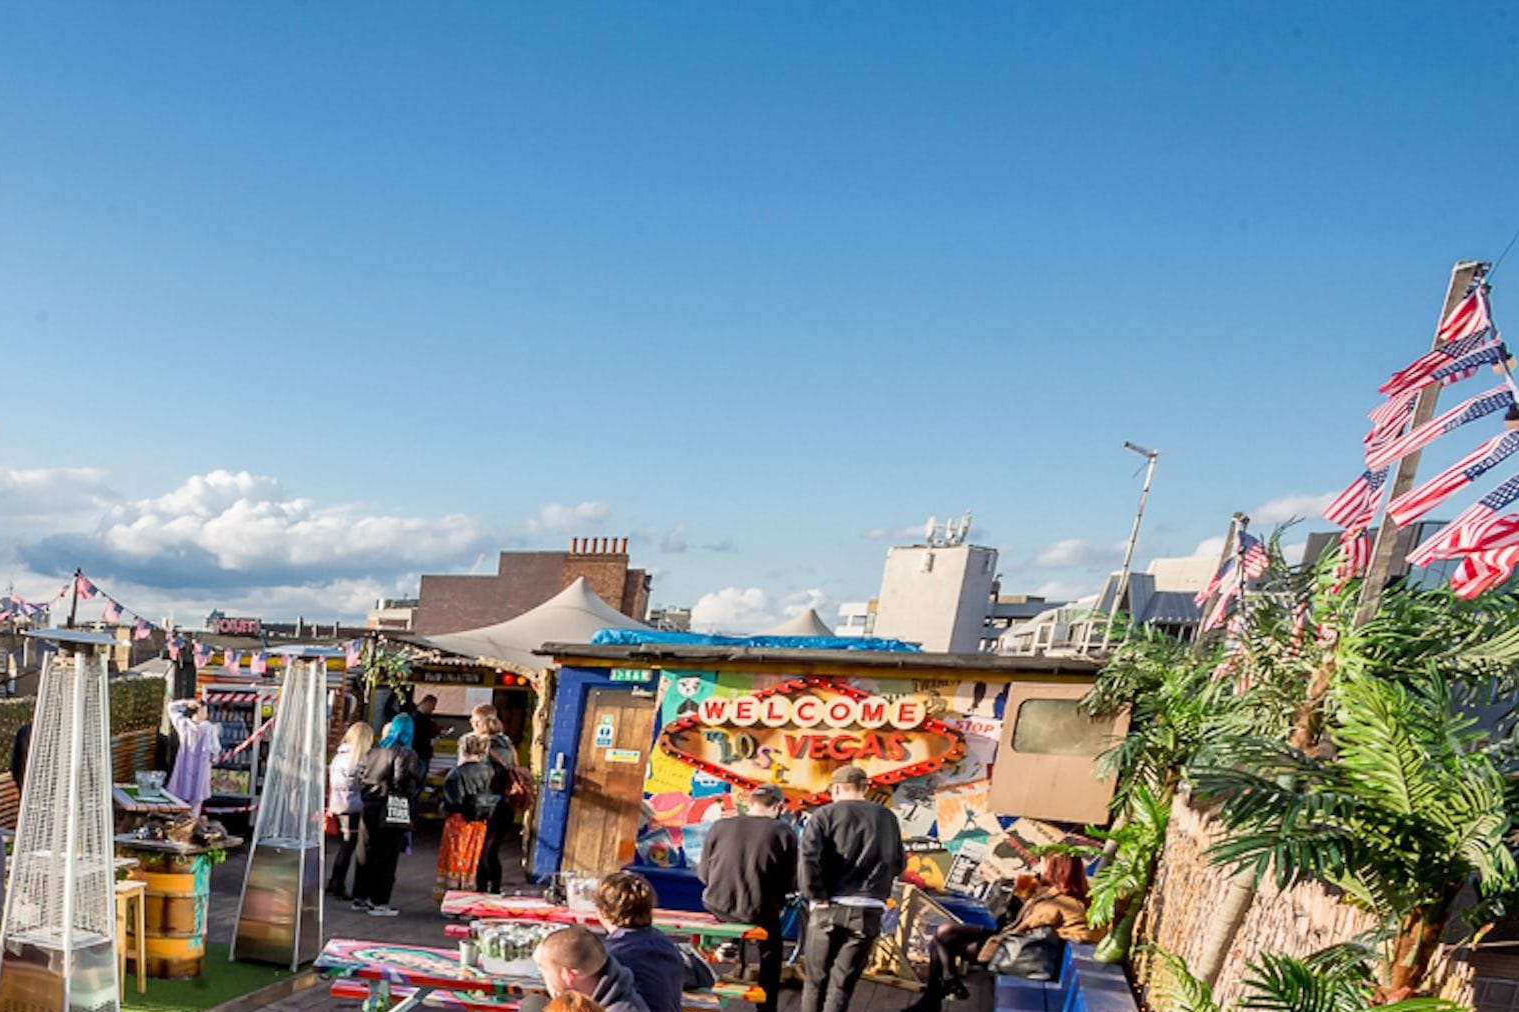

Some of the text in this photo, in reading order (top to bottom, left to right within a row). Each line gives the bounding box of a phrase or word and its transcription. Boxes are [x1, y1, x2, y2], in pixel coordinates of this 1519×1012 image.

[703, 701, 918, 724] WELCOME
[955, 719, 995, 734] STOP
[784, 732, 908, 761] VEGAS
